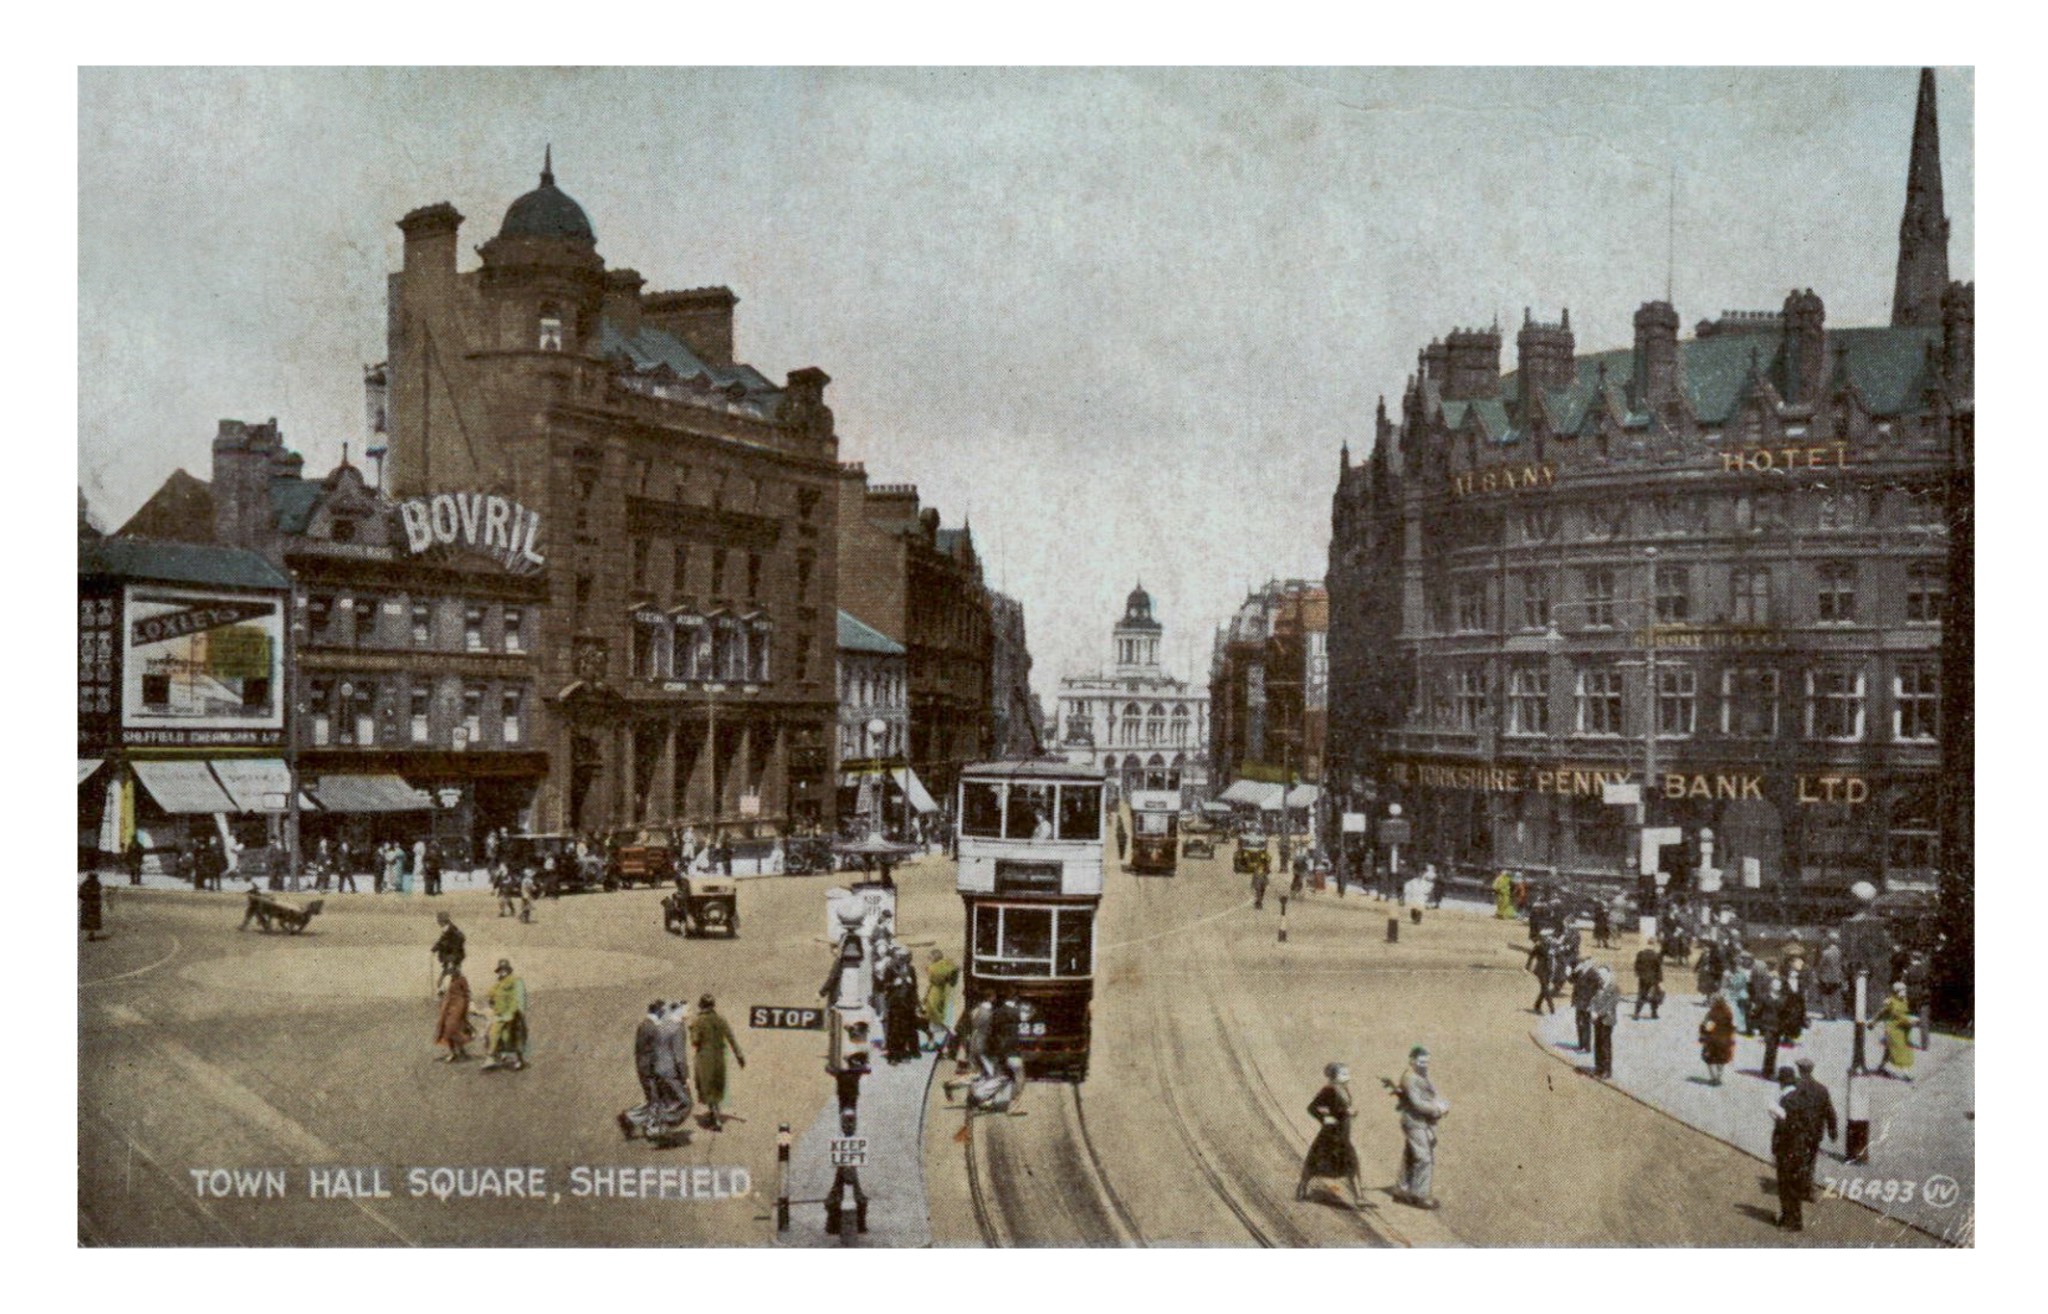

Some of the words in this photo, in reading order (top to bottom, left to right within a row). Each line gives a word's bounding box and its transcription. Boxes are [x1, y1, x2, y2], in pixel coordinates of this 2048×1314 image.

[1719, 442, 1856, 473] HOTEL
[402, 493, 545, 566] BOVRIL
[1665, 773, 1764, 800] BANK
[1798, 776, 1870, 803] LTD
[755, 1008, 815, 1027] STOP
[831, 1140, 866, 1151] KEEP
[831, 1152, 865, 1165] LEFT
